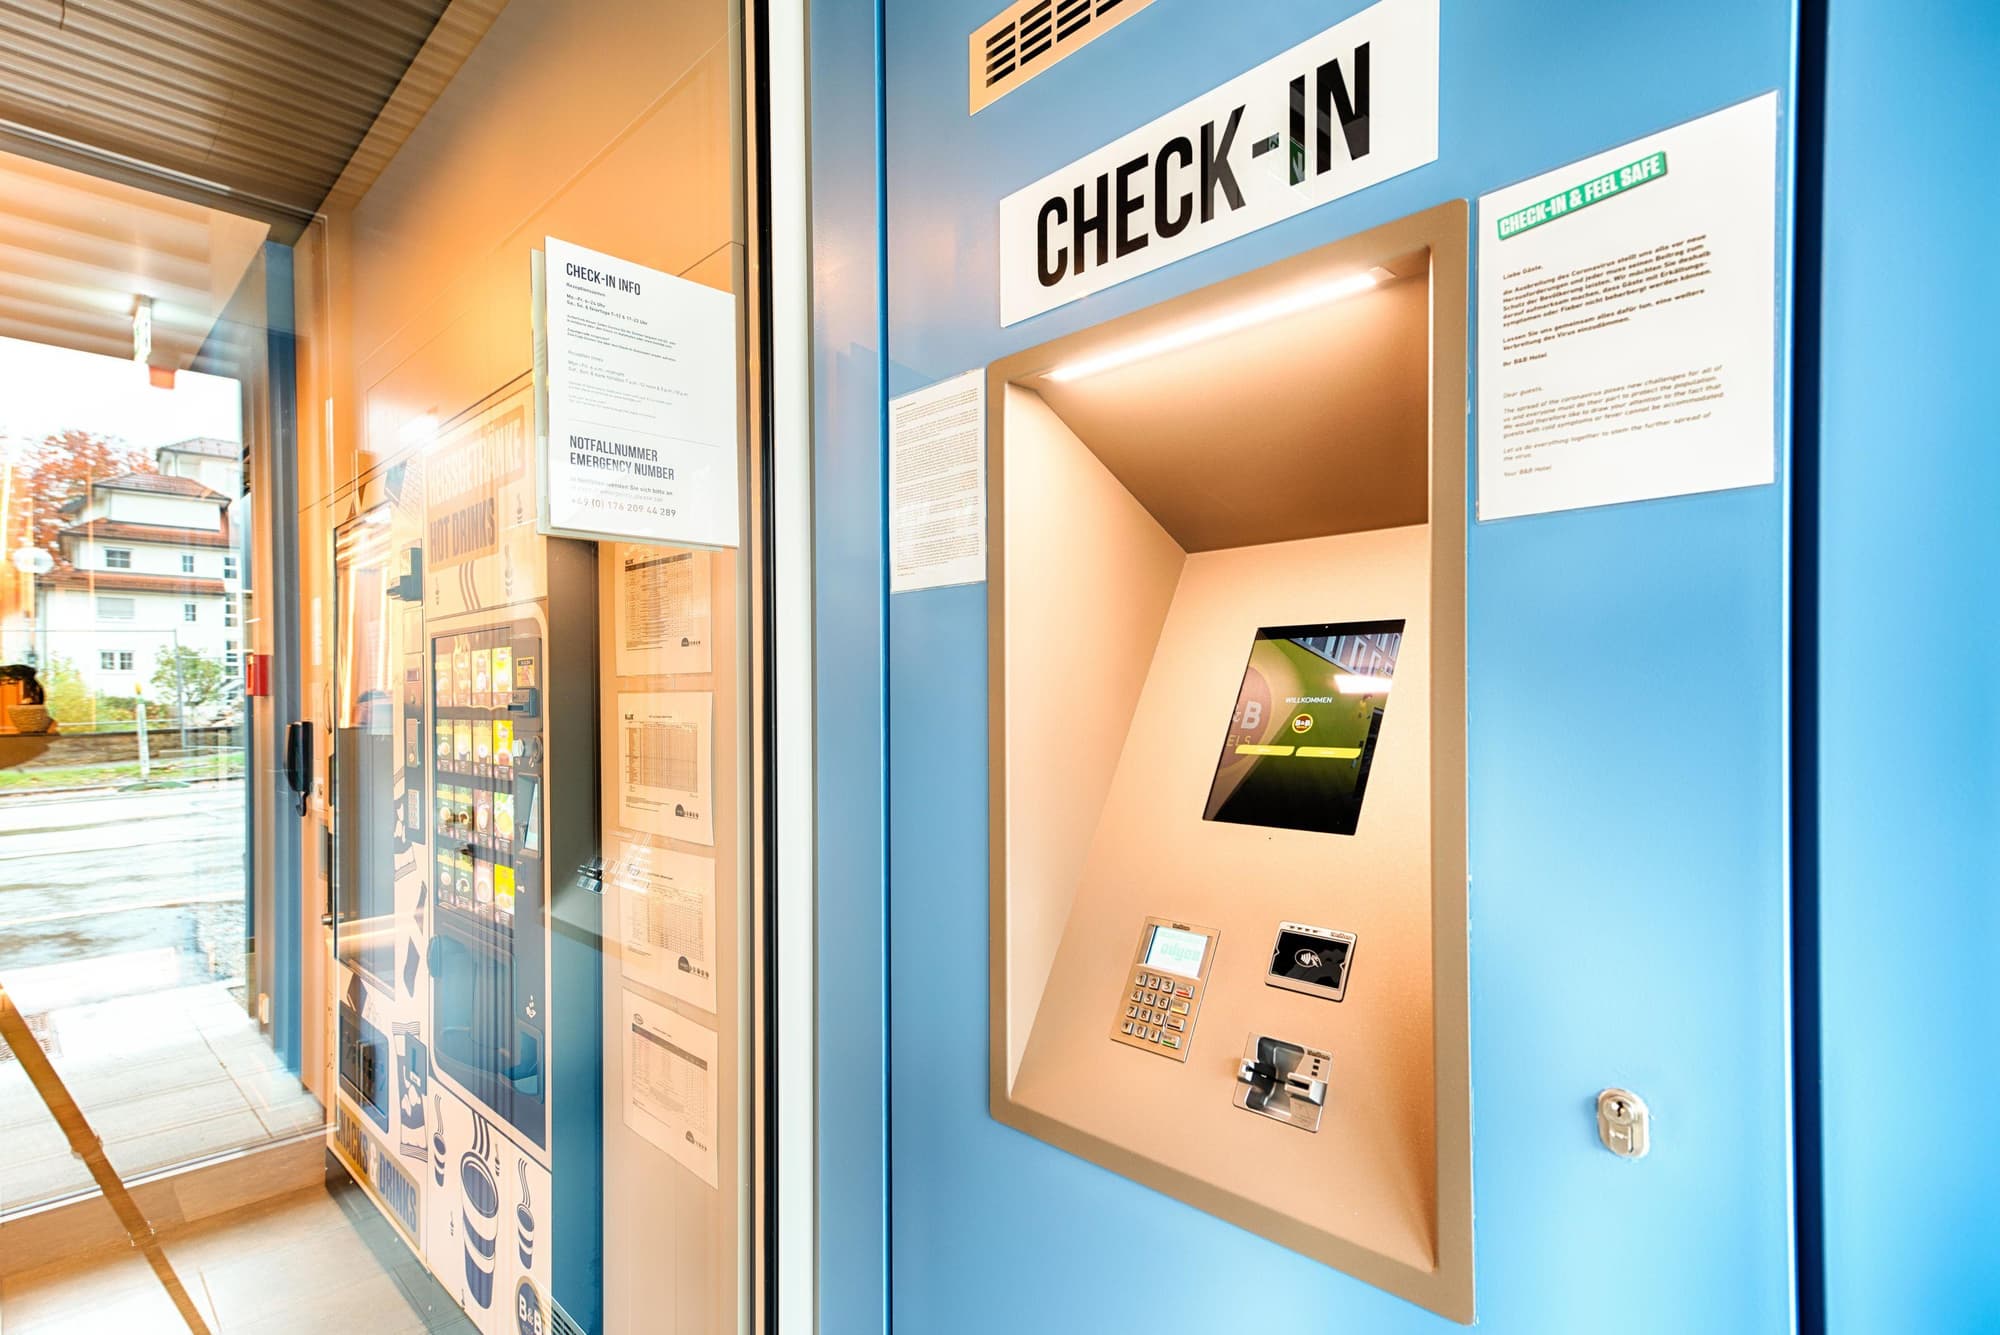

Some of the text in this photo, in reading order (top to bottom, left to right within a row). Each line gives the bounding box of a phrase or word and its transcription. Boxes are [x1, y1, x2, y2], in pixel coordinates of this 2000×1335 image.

[1037, 40, 1371, 287] CHECK-IN
[1499, 154, 1661, 237] CHECK-IN & FEEL SAFE
[566, 263, 616, 288] CHECK-IN
[618, 275, 641, 296] INFO
[569, 435, 658, 462] NOTFALLNUMMER
[570, 452, 675, 480] EMERGENCY NUMBER
[608, 501, 624, 511] 176
[627, 502, 643, 512] 209
[647, 505, 658, 515] 44
[660, 506, 676, 518] 289
[430, 497, 495, 564] HOT DRINKS
[1285, 696, 1333, 704] WILLKOMMEN
[369, 1142, 378, 1187] &
[379, 1151, 417, 1233] DRINKS
[519, 1293, 542, 1335] B&B
